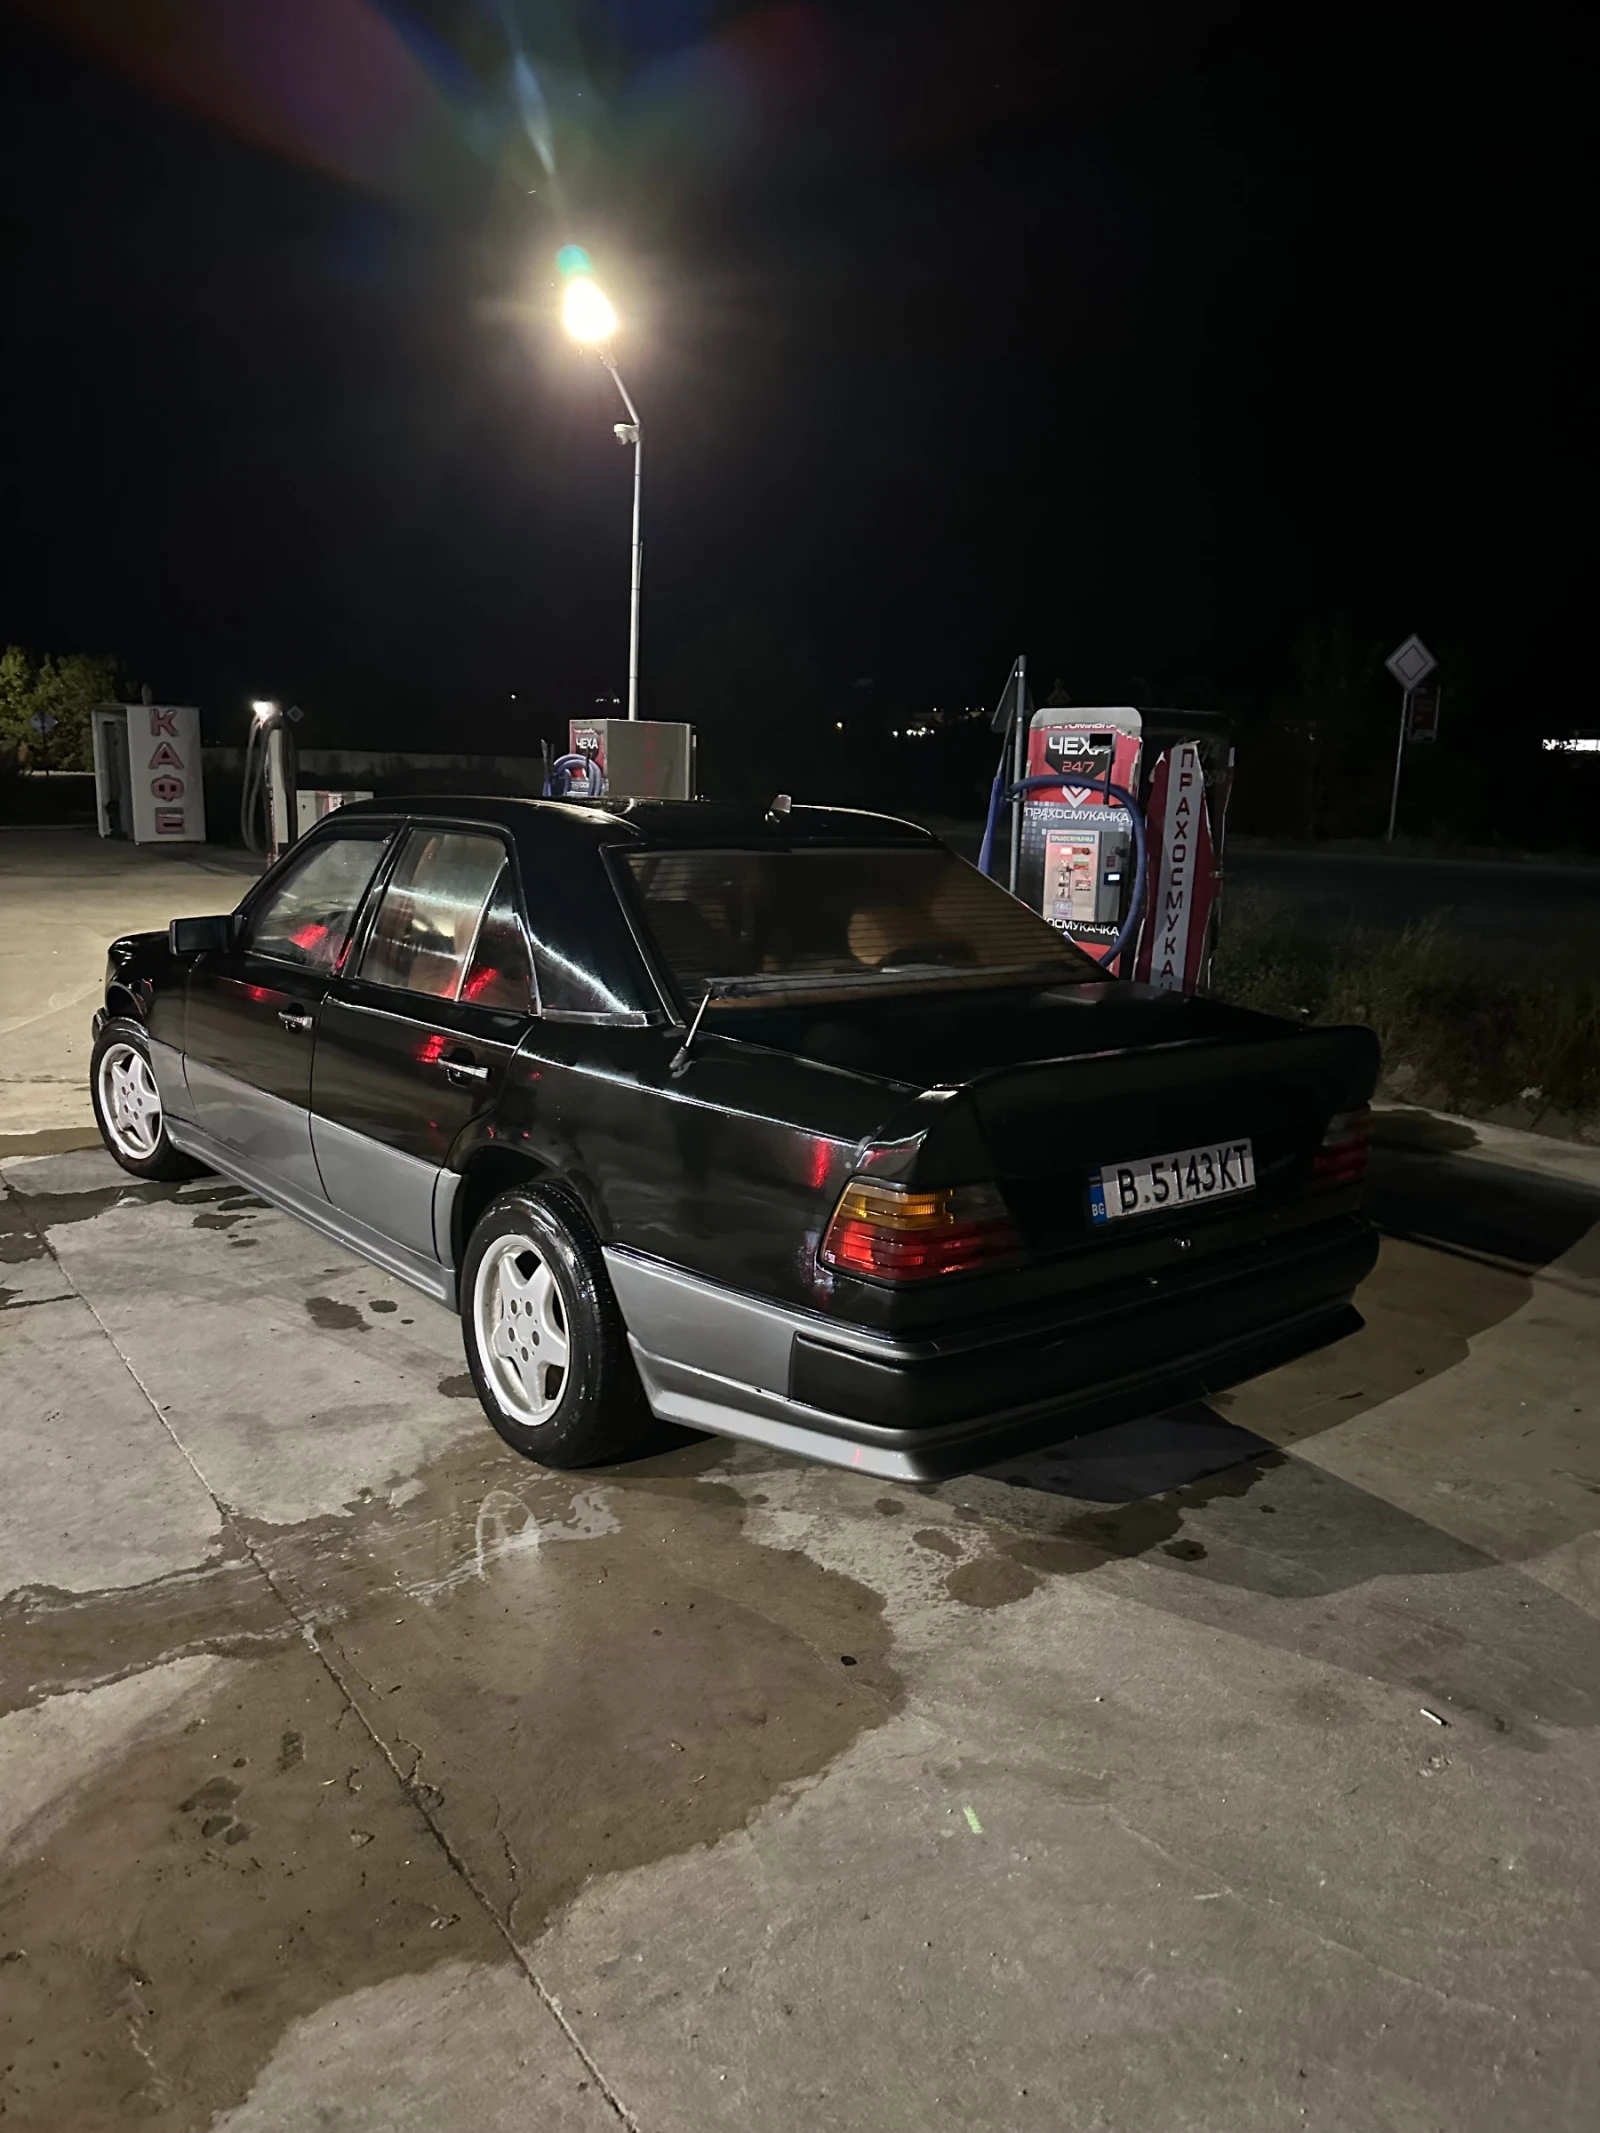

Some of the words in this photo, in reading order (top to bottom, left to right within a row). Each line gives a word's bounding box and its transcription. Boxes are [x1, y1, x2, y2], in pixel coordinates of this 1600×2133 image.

[576, 738, 598, 749] ЧЕХА
[1049, 736, 1111, 755] ЧЕХ
[148, 708, 185, 835] КАФЕ
[1062, 761, 1094, 773] 24/7
[1025, 807, 1130, 823] ПРАХОСМУКАЧКА
[1044, 918, 1120, 936] ОСМУКАЧКА
[1092, 1203, 1105, 1217] BG
